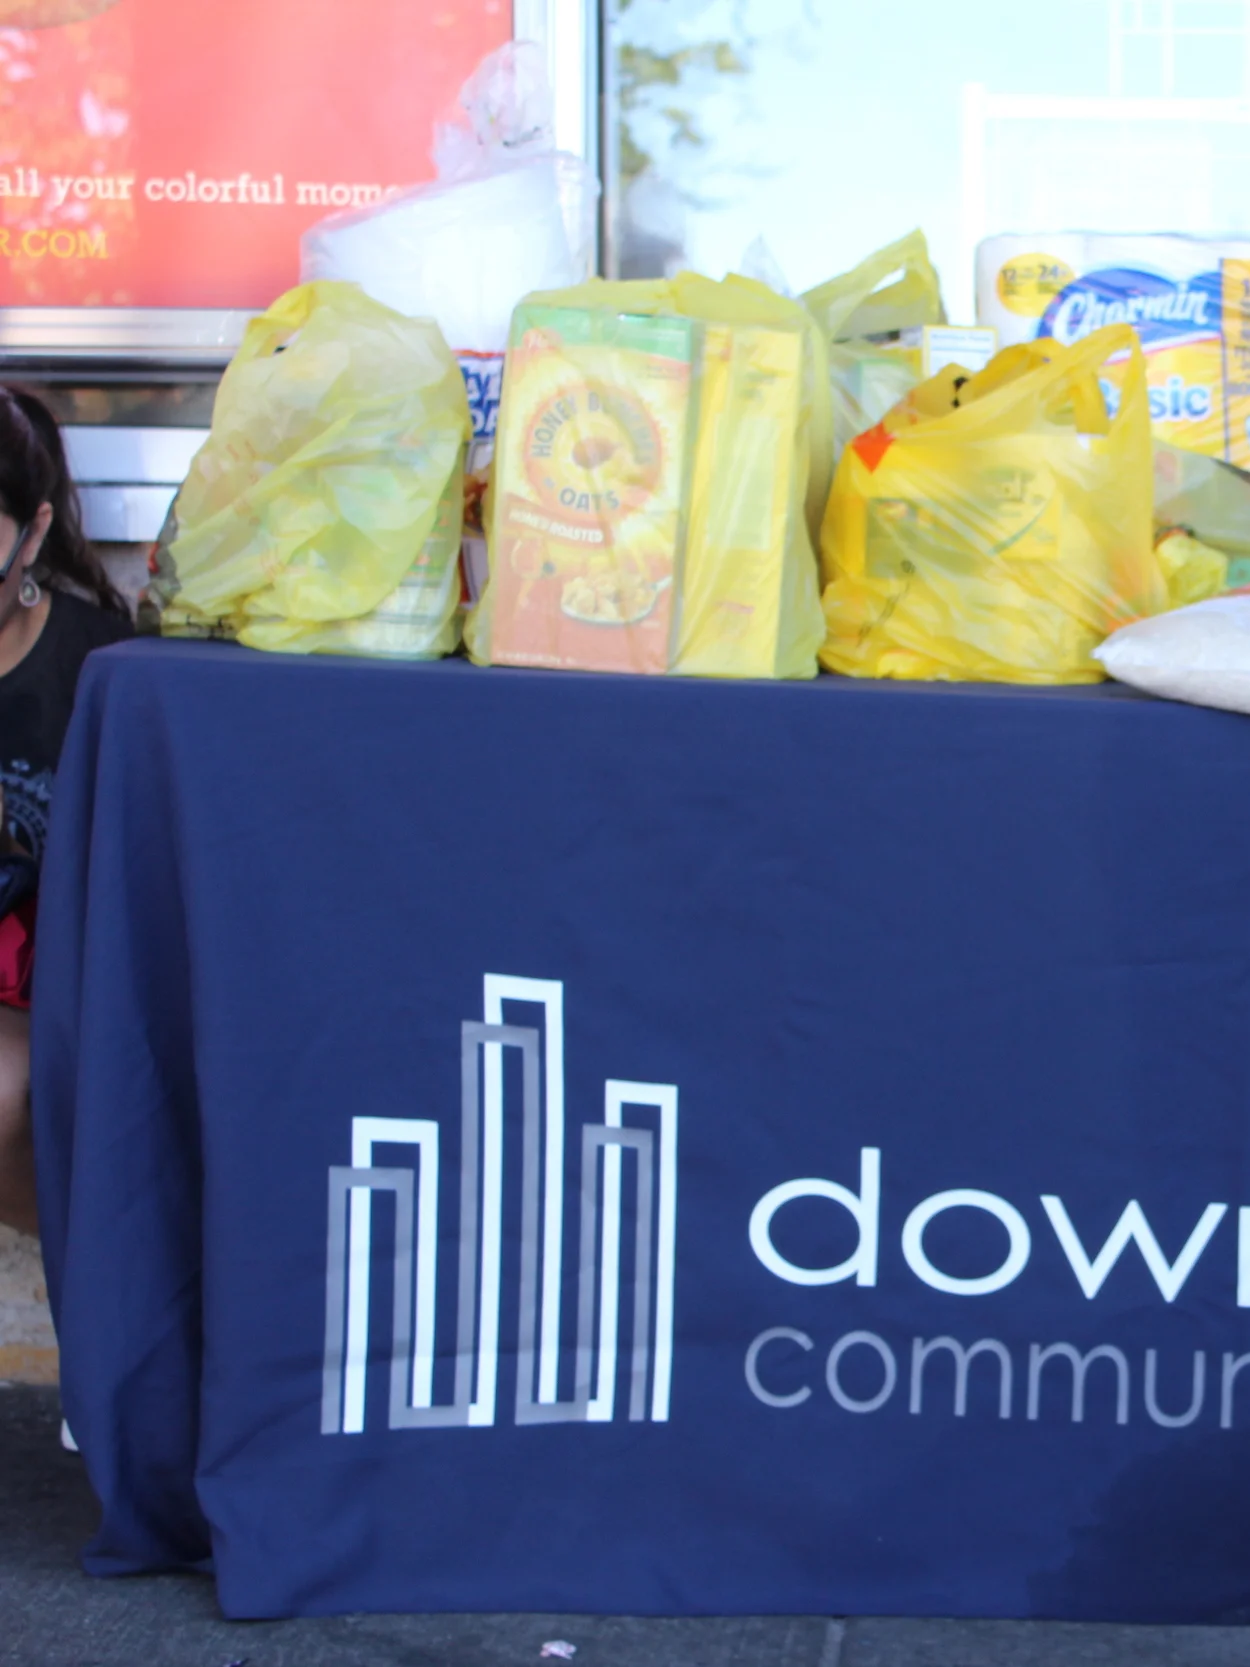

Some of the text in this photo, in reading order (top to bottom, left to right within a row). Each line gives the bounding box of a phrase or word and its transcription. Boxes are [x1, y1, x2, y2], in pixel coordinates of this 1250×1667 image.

[0, 167, 40, 197] all
[51, 172, 135, 206] your
[145, 171, 285, 205] colorful
[1051, 281, 1209, 347] Charmin
[558, 486, 620, 513] OATS
